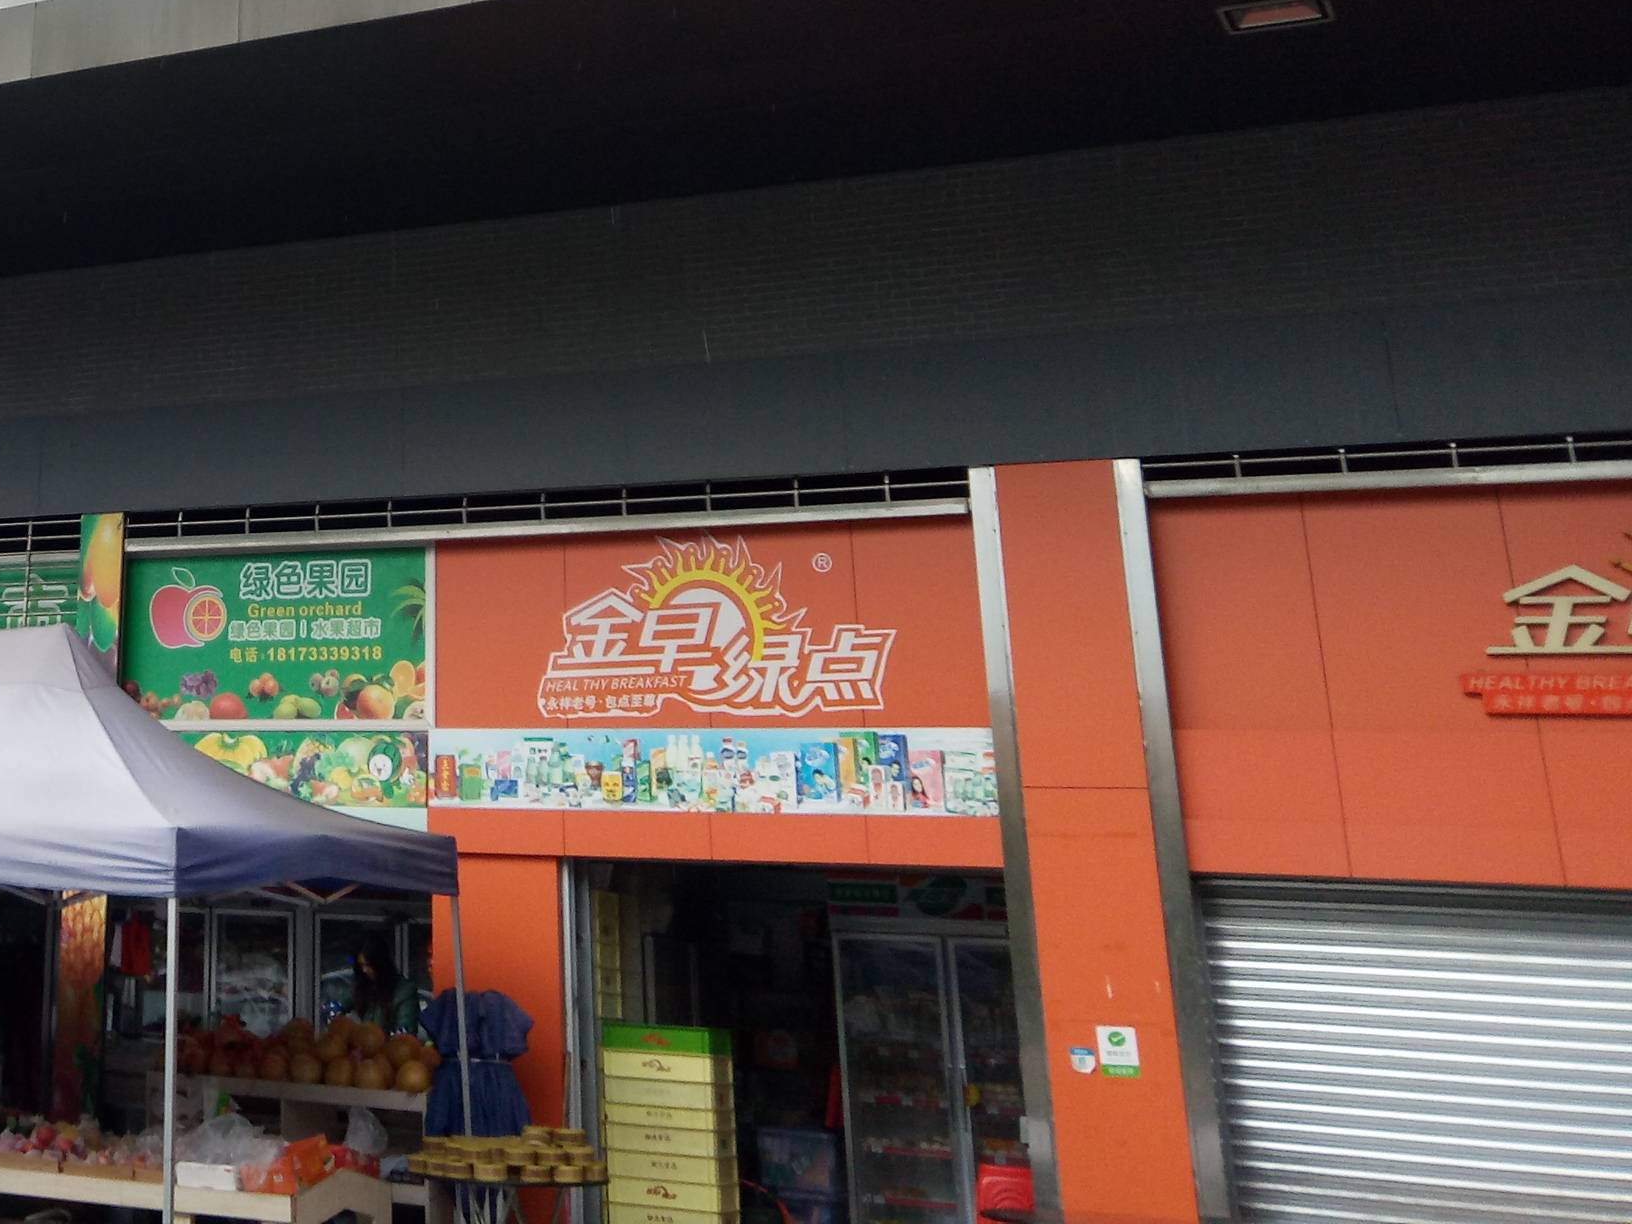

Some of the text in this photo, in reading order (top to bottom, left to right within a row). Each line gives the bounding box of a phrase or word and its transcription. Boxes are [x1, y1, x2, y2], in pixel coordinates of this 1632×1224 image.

[240, 559, 371, 600] 绿色果园
[248, 601, 362, 617] Green orchard
[1485, 564, 1632, 654] 金
[611, 675, 687, 690] BREAKFAST
[1470, 676, 1568, 691] HEALTHY
